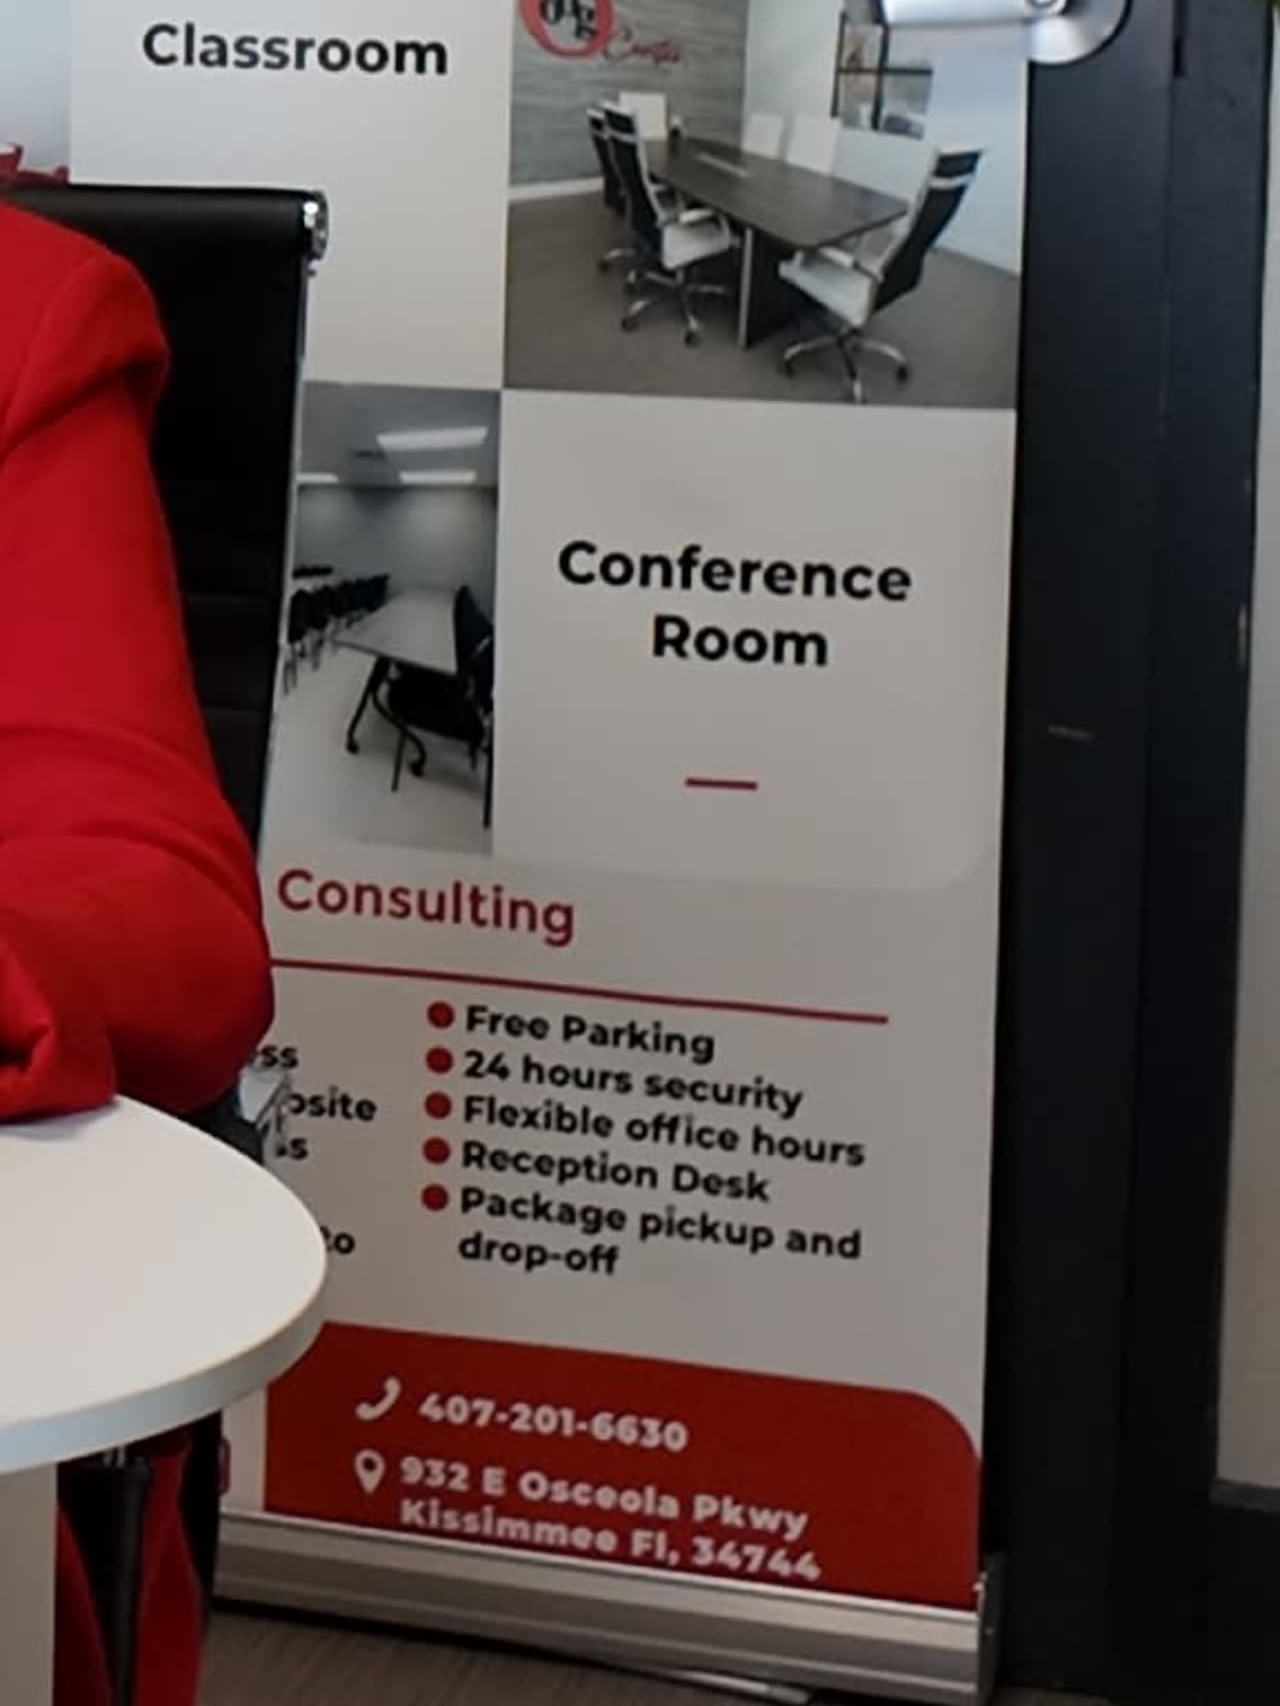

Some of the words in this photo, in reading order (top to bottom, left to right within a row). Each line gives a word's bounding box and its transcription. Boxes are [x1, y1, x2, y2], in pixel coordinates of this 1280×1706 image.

[143, 22, 448, 75] Classroom
[558, 540, 911, 602] Conference
[653, 614, 828, 667] Room
[275, 866, 576, 948] Consulting
[466, 1004, 550, 1040] Free
[562, 1015, 715, 1066] Parking
[464, 1049, 510, 1081] 24
[522, 1054, 633, 1095] hours
[644, 1075, 803, 1120] security
[464, 1095, 614, 1138] Flexible
[625, 1113, 740, 1152] office
[752, 1125, 865, 1167] hours
[462, 1139, 658, 1189] Reception
[672, 1163, 769, 1202] Desk
[458, 1231, 619, 1275] drop-off
[460, 1186, 627, 1236] Package
[639, 1206, 775, 1254] pickup
[785, 1229, 861, 1259] and
[419, 1393, 688, 1452] 407-201-6630
[401, 1456, 469, 1491] 932
[482, 1466, 505, 1496] E
[519, 1471, 680, 1519] Osceola
[693, 1494, 808, 1541] Pkwy
[400, 1498, 618, 1556] Kissimmee
[693, 1537, 820, 1579] 34744
